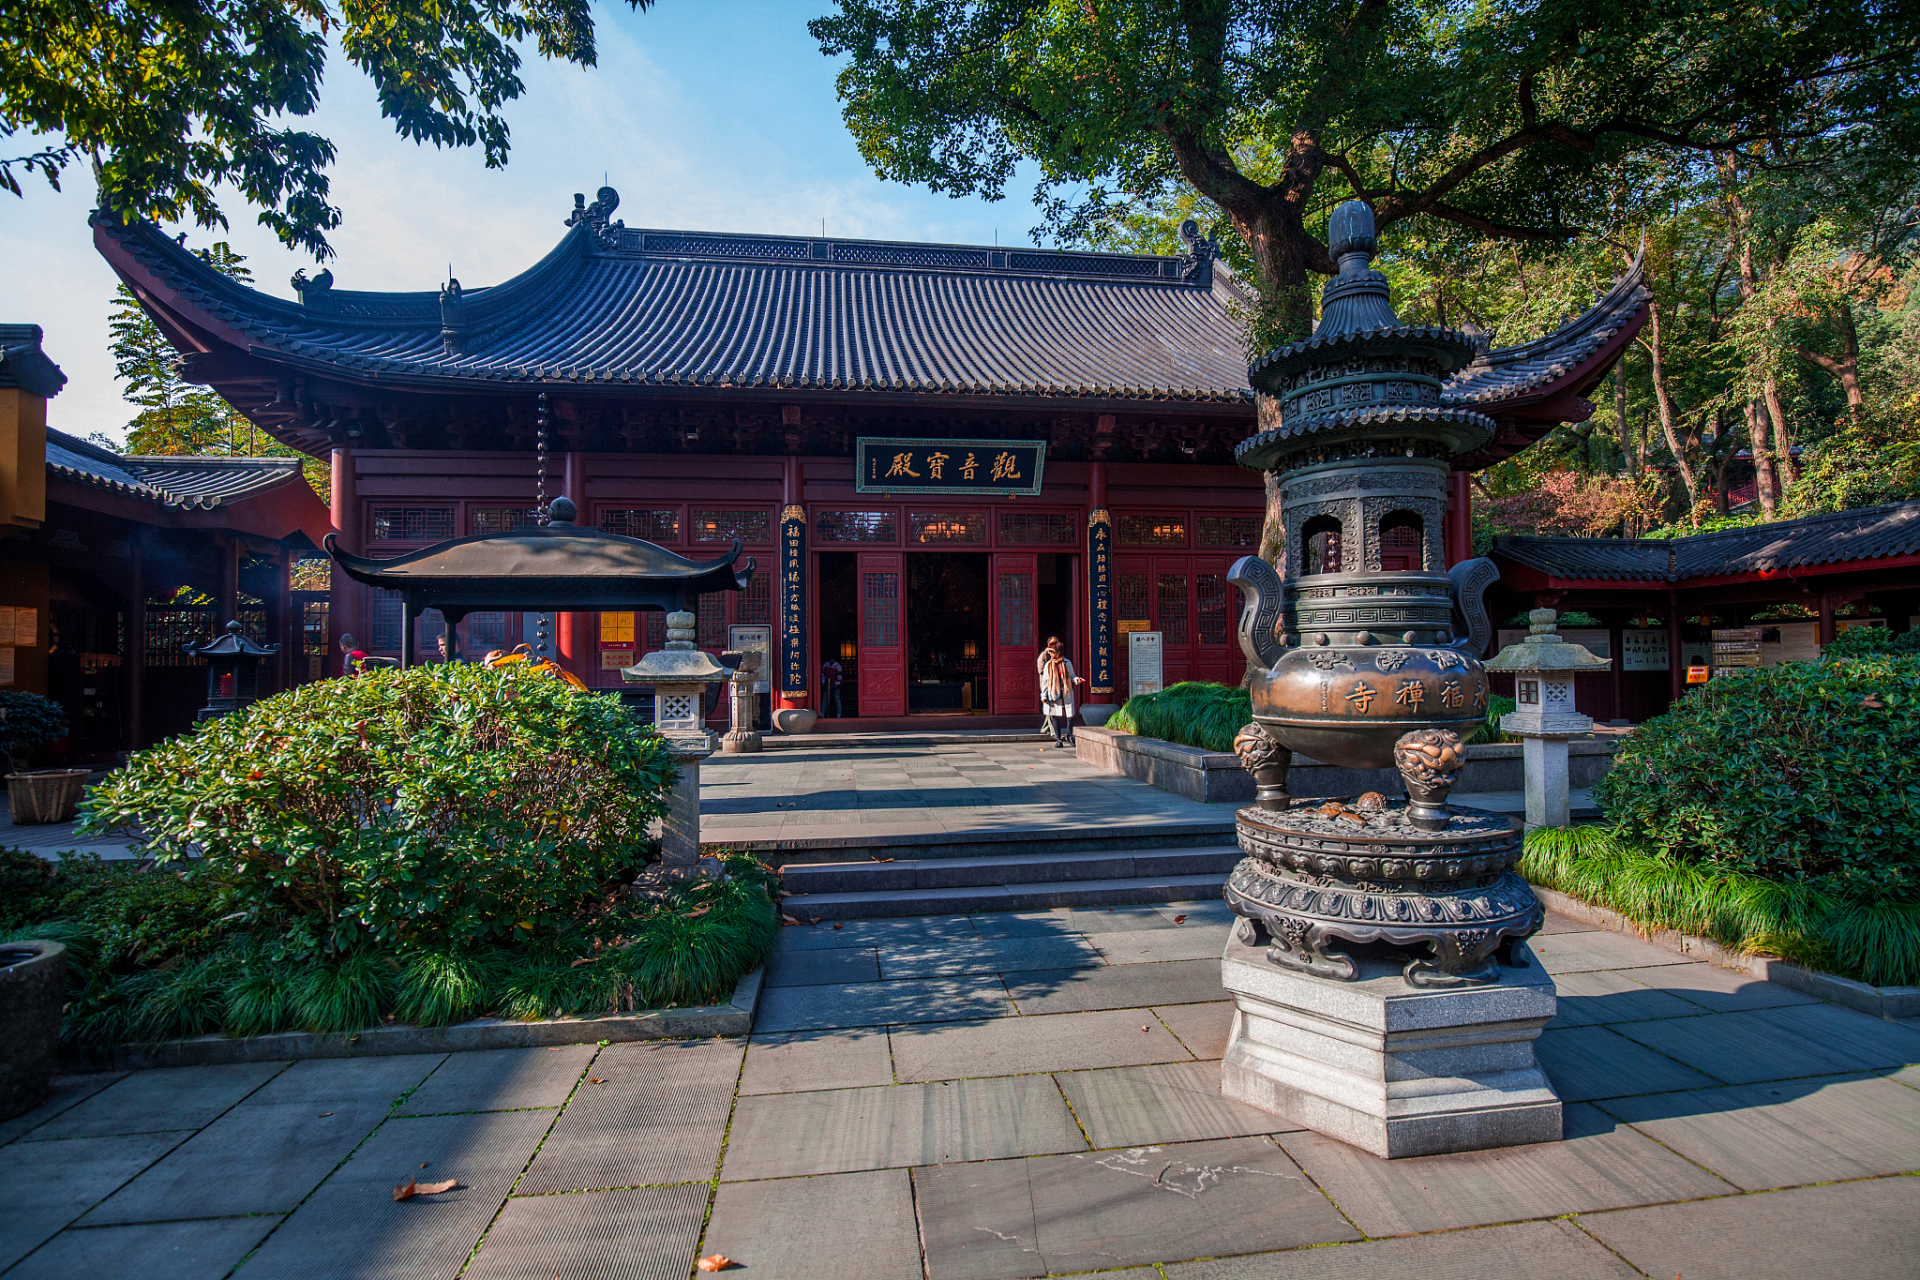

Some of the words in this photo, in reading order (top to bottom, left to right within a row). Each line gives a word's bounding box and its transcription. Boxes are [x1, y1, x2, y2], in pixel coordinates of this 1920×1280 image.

[885, 452, 1021, 482] 觀音寶殿
[1345, 680, 1487, 714] 永福禪寺
